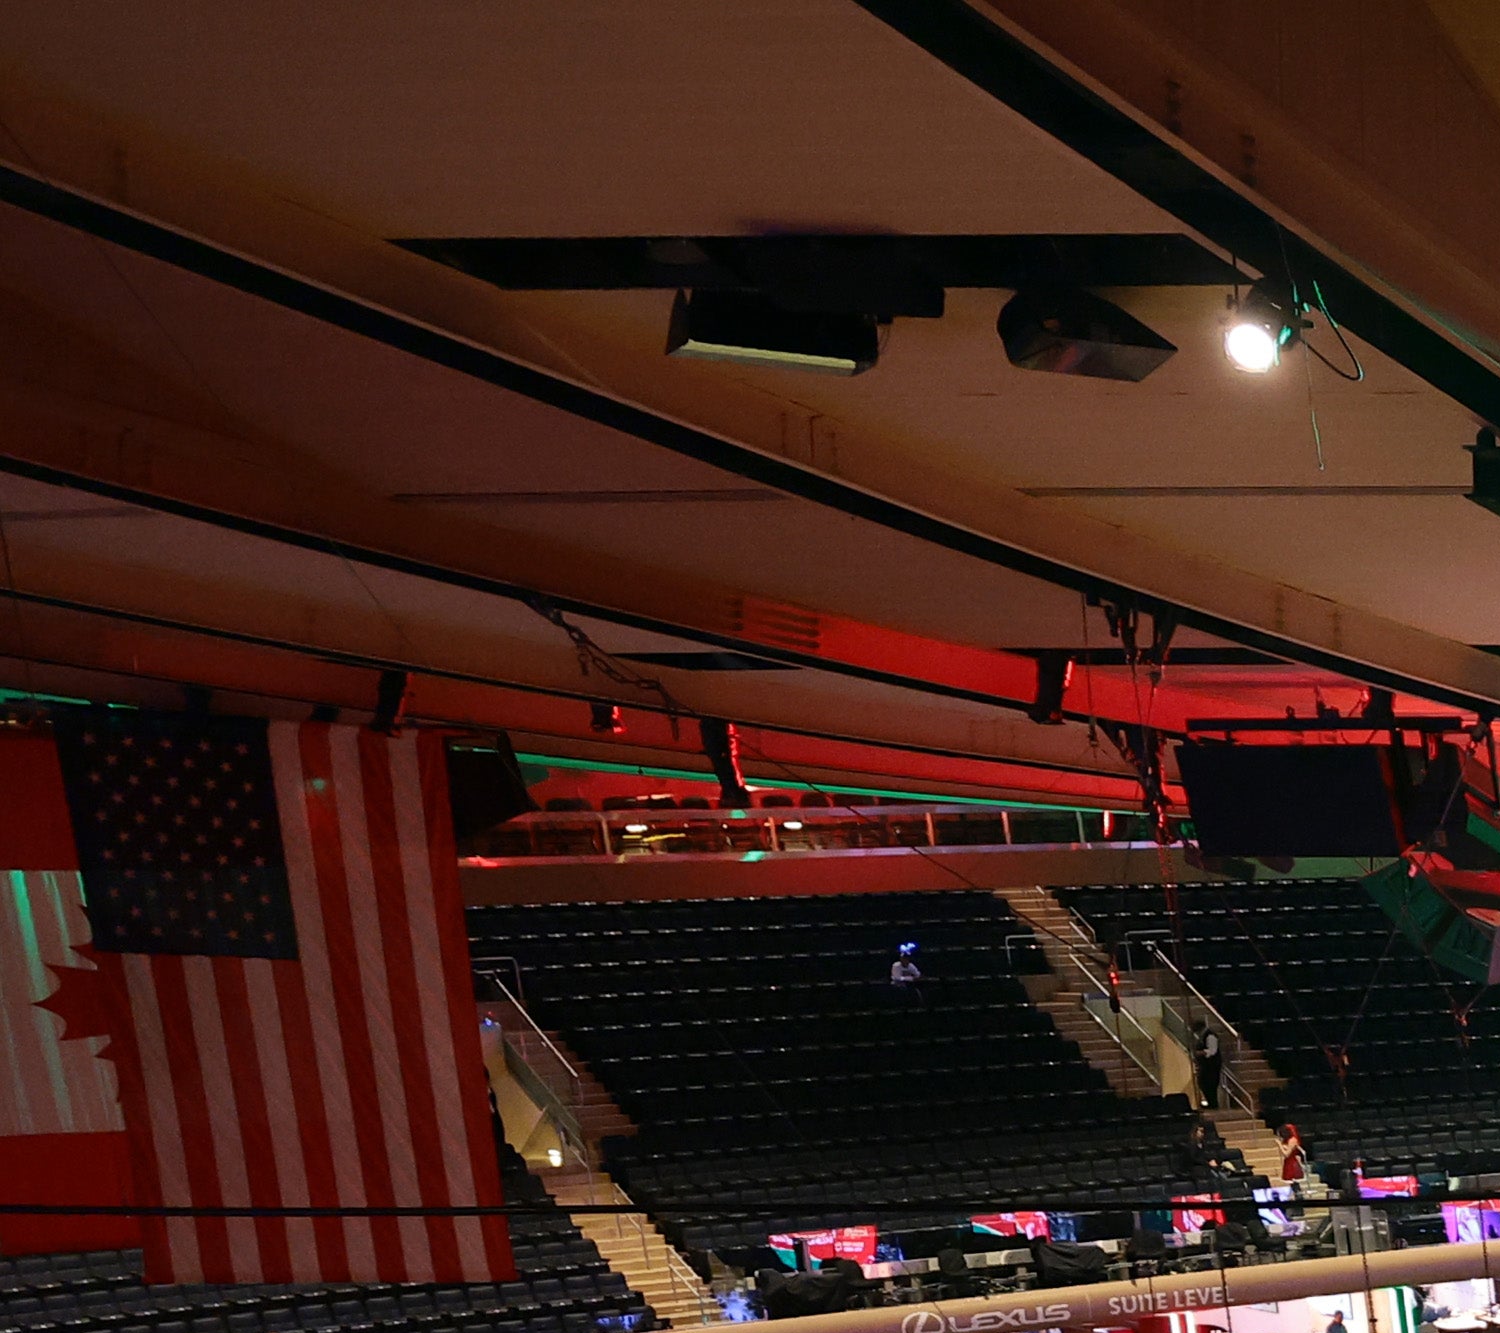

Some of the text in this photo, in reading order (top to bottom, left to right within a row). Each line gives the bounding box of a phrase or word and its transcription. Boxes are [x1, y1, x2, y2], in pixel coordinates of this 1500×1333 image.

[1108, 1285, 1235, 1315] SUITE LEVEL
[947, 1303, 1072, 1332] LEXUS
